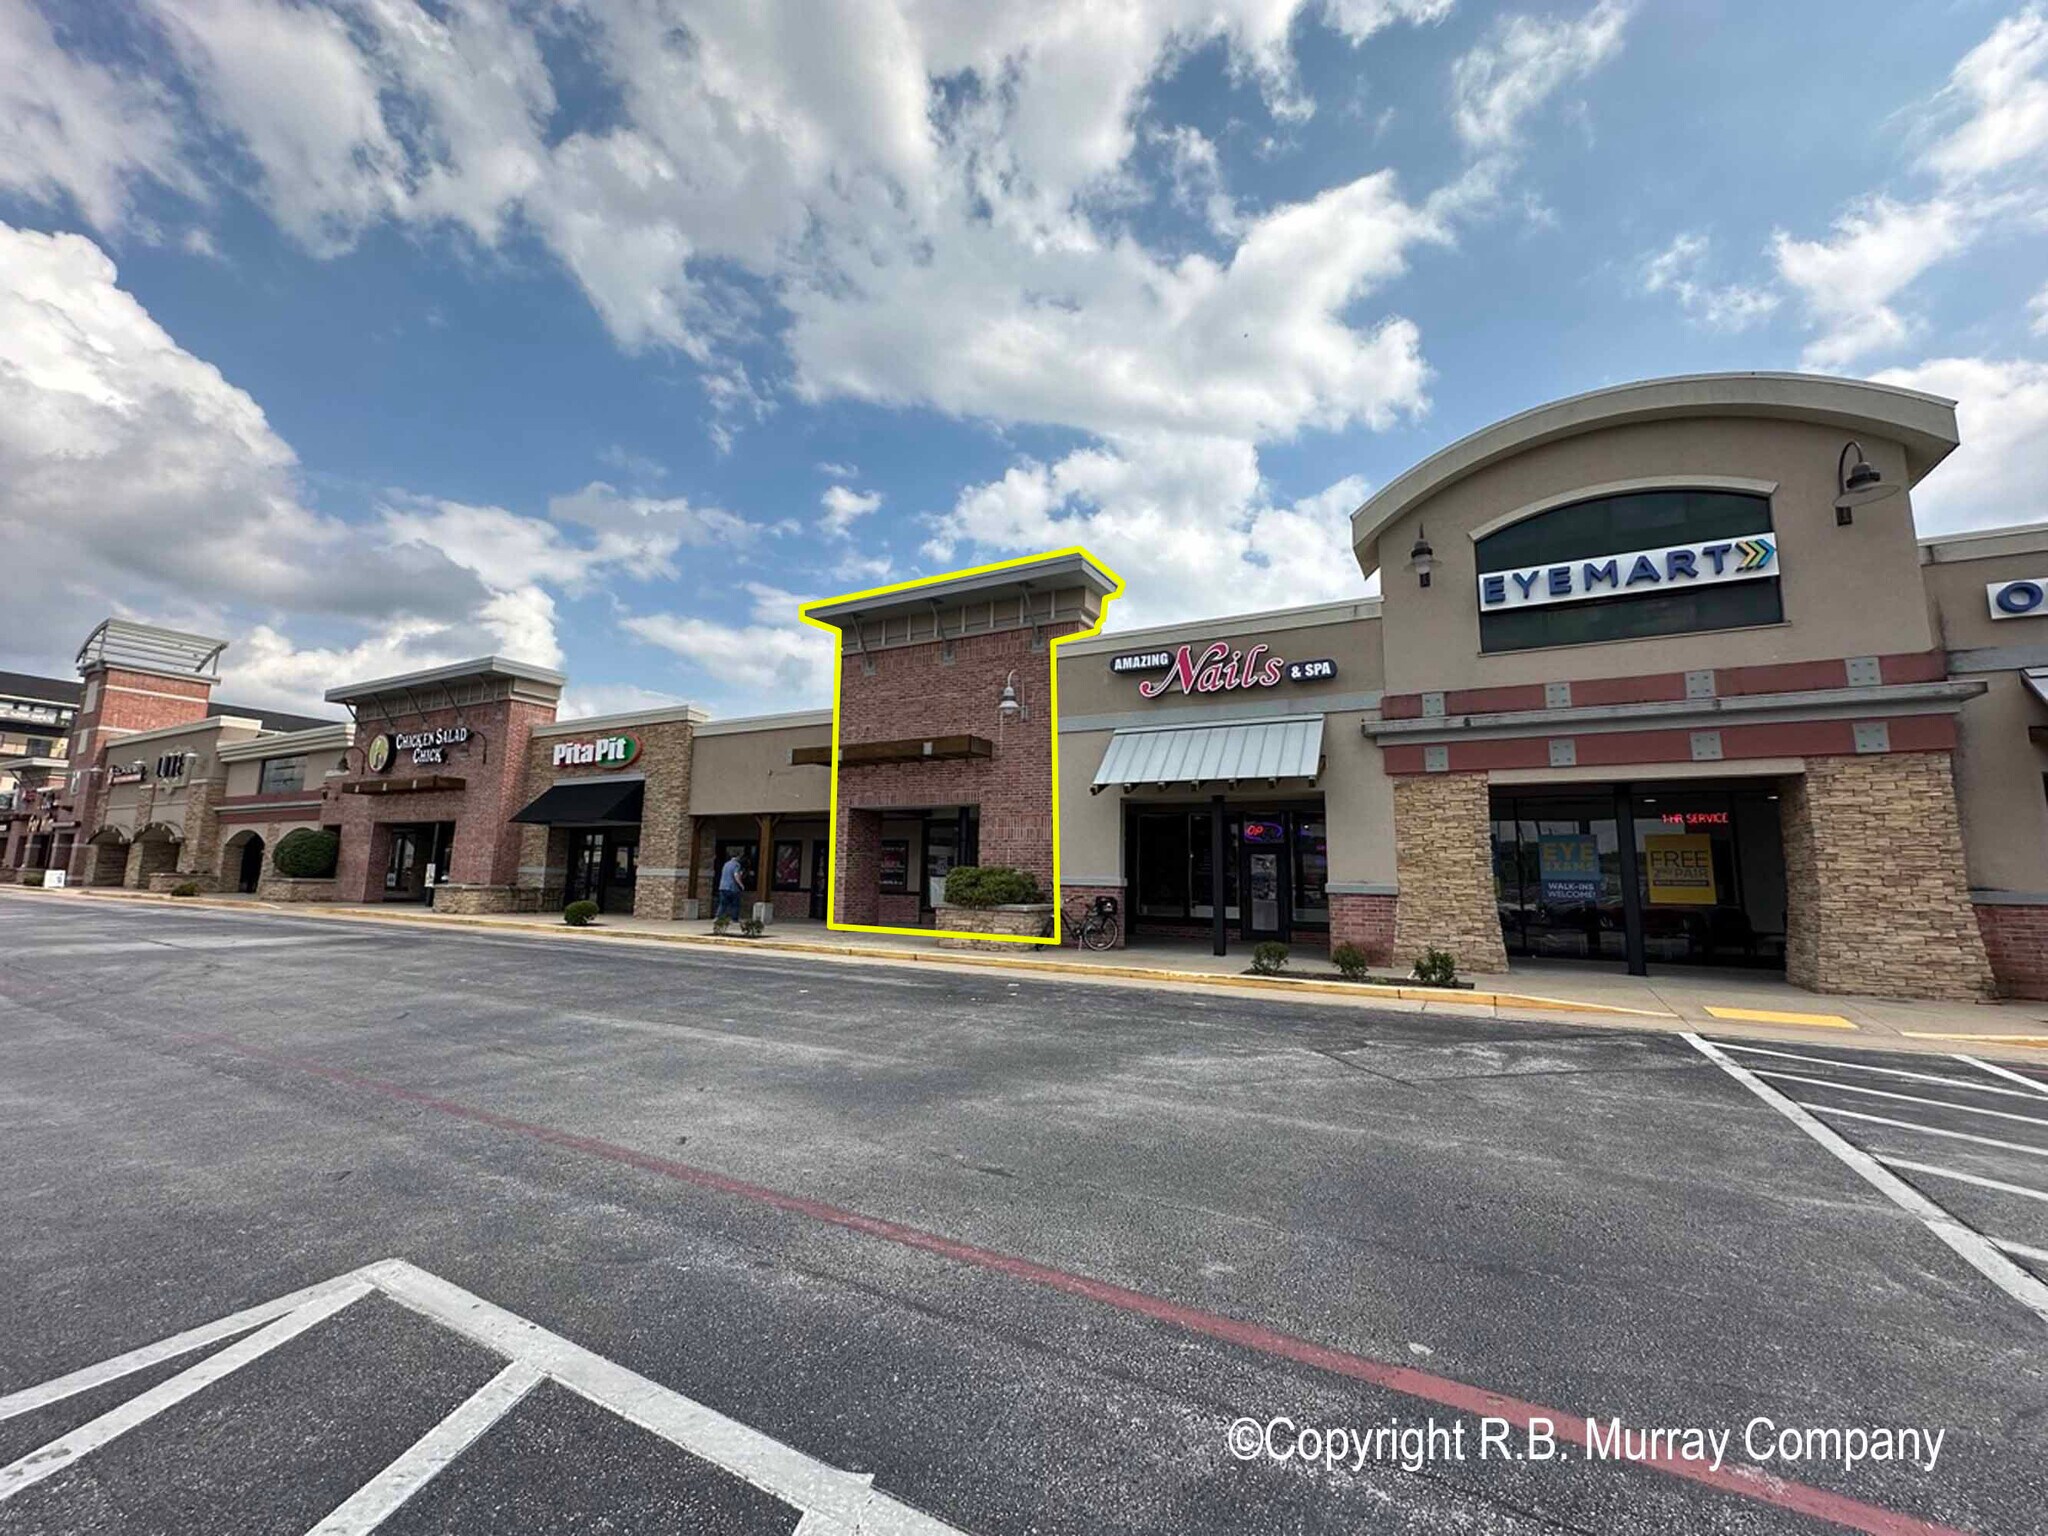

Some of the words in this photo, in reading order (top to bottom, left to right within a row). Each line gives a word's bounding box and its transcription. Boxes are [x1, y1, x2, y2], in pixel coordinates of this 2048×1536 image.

[1483, 543, 1732, 604] EYEMART
[1114, 652, 1169, 671] AMAZING
[1139, 641, 1284, 698] Nails
[1304, 661, 1332, 676] SPA
[1290, 666, 1302, 679] &
[395, 731, 434, 750] CHICKEN
[435, 727, 468, 745] SALAD
[412, 747, 443, 764] CHICK
[552, 742, 594, 766] Pita
[595, 737, 627, 762] Pit
[1685, 811, 1730, 824] SERVICE
[1543, 842, 1595, 861] EYE
[1650, 850, 1709, 868] FREE
